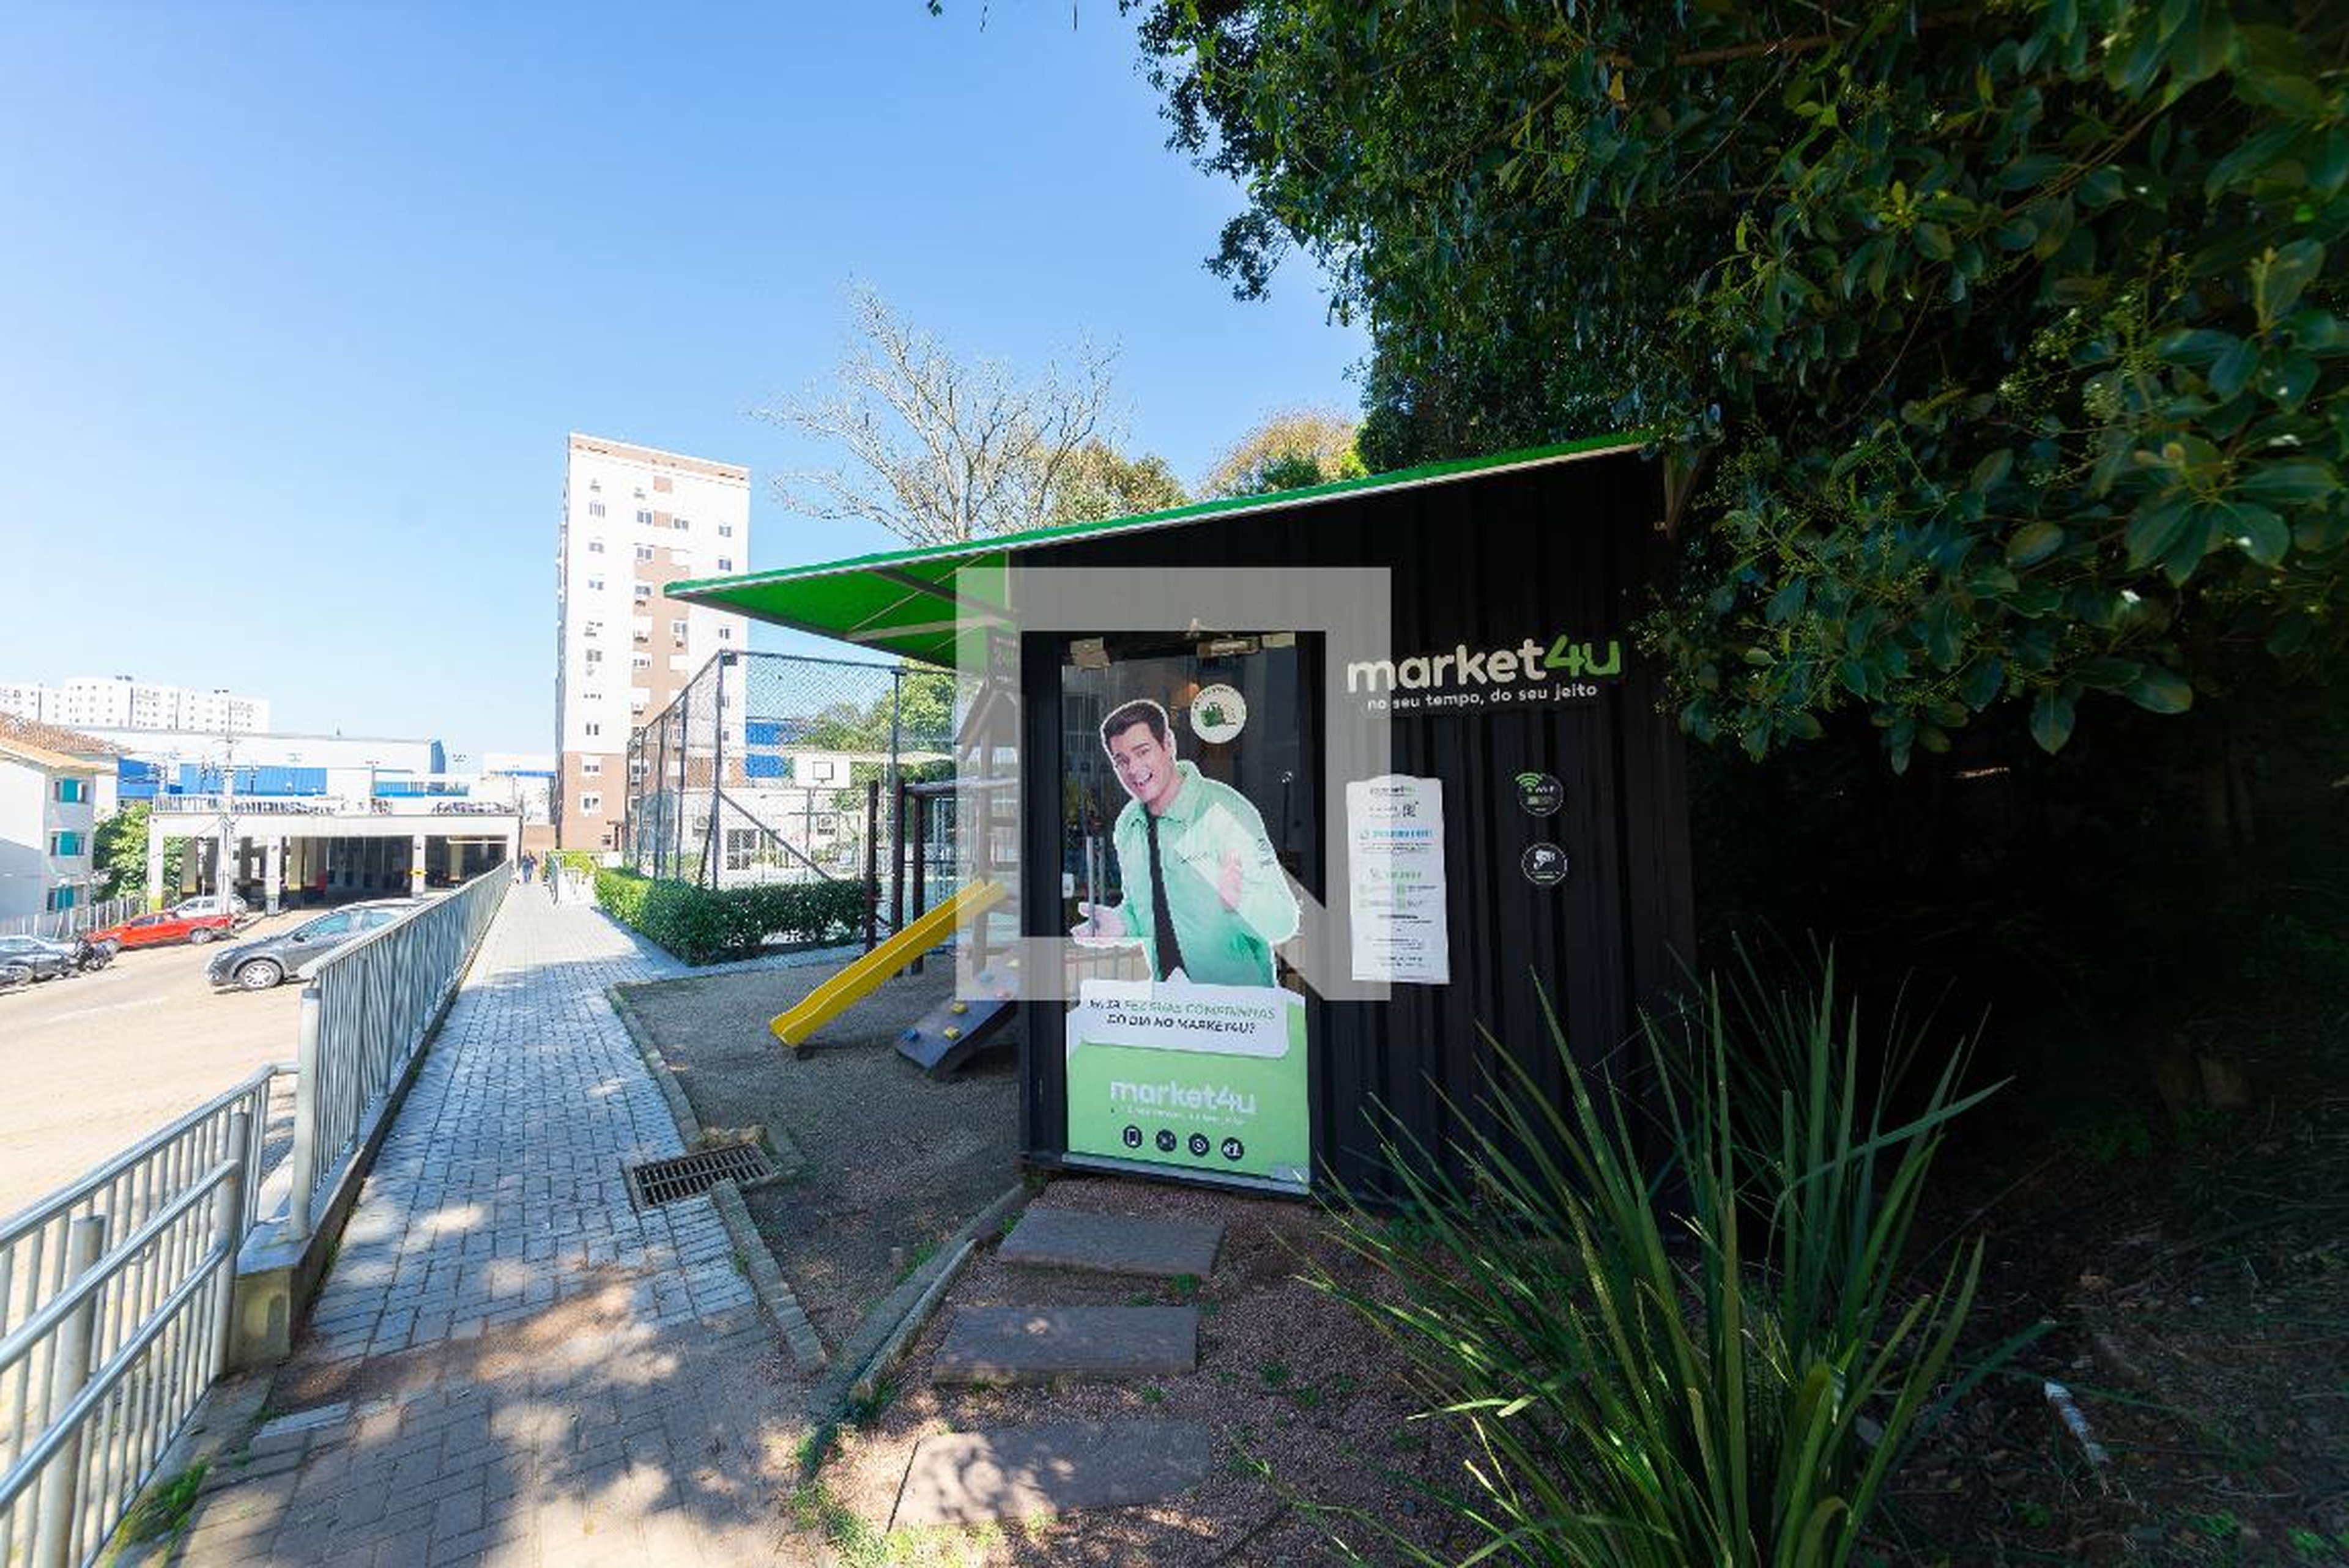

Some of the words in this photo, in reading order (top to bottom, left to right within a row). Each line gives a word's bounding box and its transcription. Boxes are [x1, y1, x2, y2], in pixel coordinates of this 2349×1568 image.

[1346, 634, 1621, 693] market4u
[1367, 698, 1386, 710] no
[1392, 697, 1420, 709] seu
[1425, 693, 1485, 708] tempo,
[1490, 688, 1513, 703] do
[1518, 689, 1548, 701] seu
[1554, 683, 1598, 702] jeito
[1110, 1080, 1257, 1115] market4u
